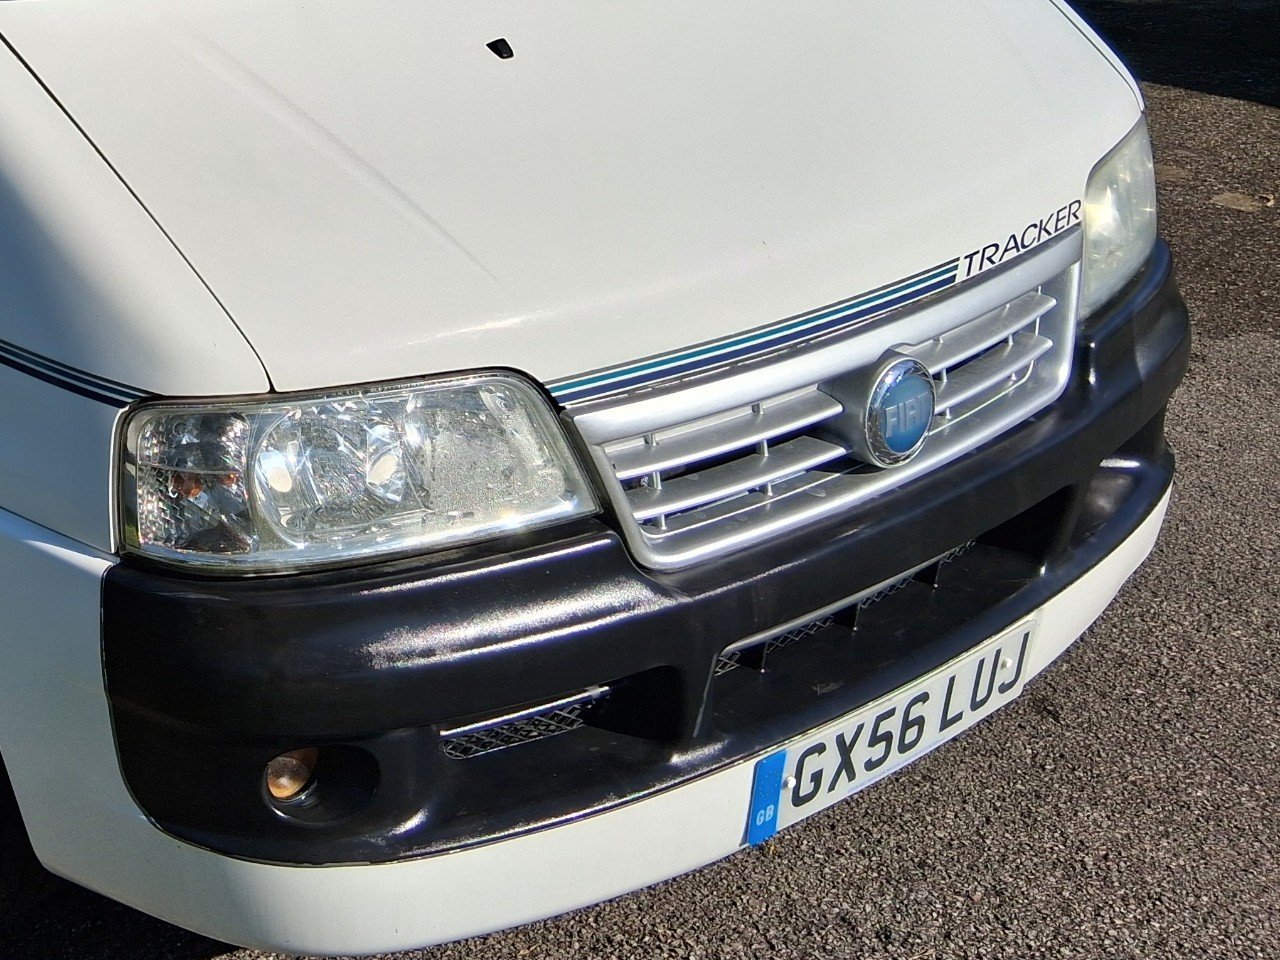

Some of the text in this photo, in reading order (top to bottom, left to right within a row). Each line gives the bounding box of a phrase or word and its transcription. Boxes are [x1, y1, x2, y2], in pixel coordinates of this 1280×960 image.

[963, 199, 1082, 278] TRACKER
[885, 391, 932, 438] FIAT
[791, 691, 930, 808] GX56
[938, 631, 1030, 733] LUJ
[755, 803, 775, 827] GB
